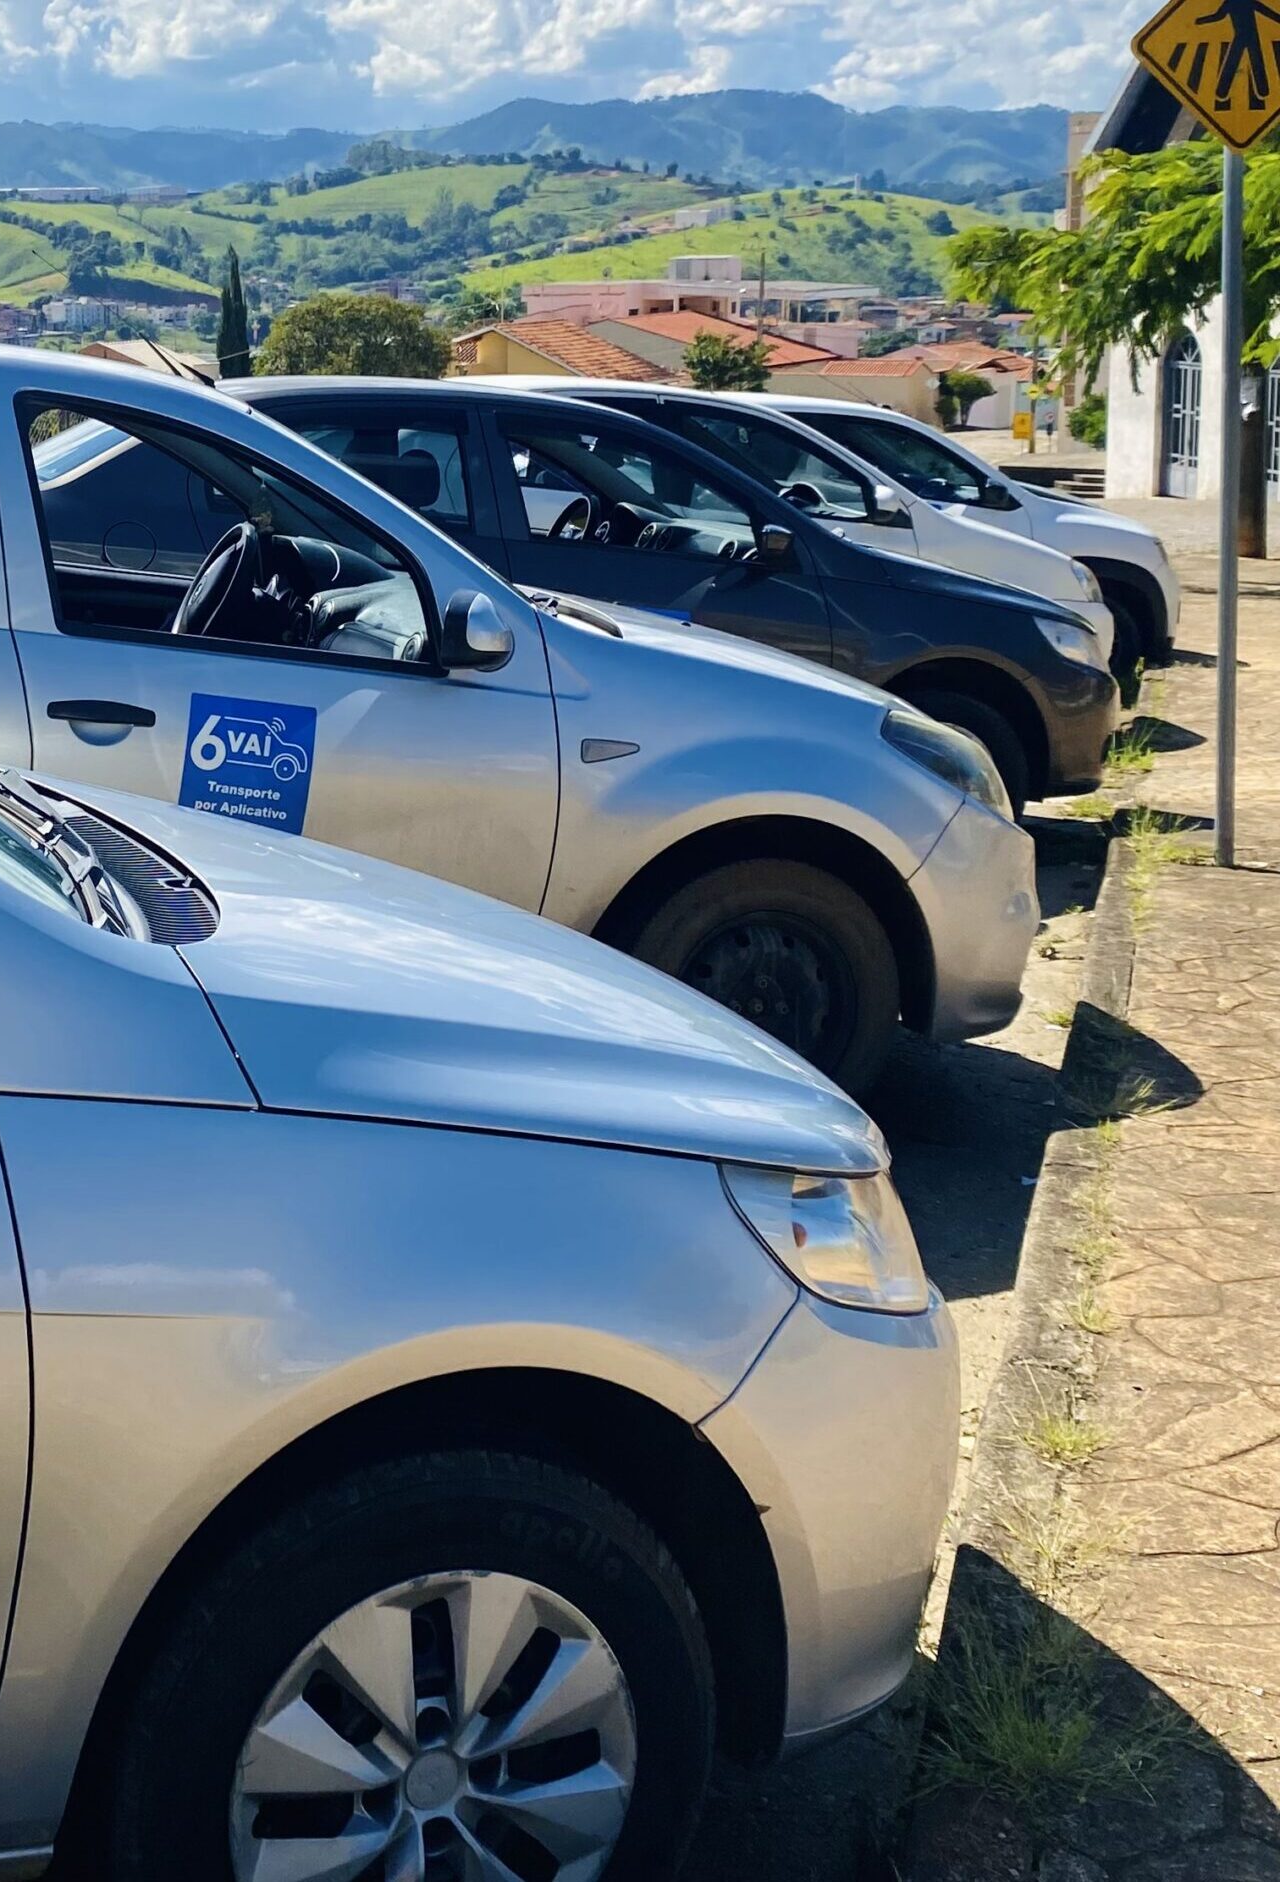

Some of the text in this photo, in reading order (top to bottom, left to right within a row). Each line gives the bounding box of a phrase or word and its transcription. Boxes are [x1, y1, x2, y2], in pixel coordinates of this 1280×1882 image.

[207, 780, 281, 801] Transporte
[194, 799, 287, 820] por Aplicativo
